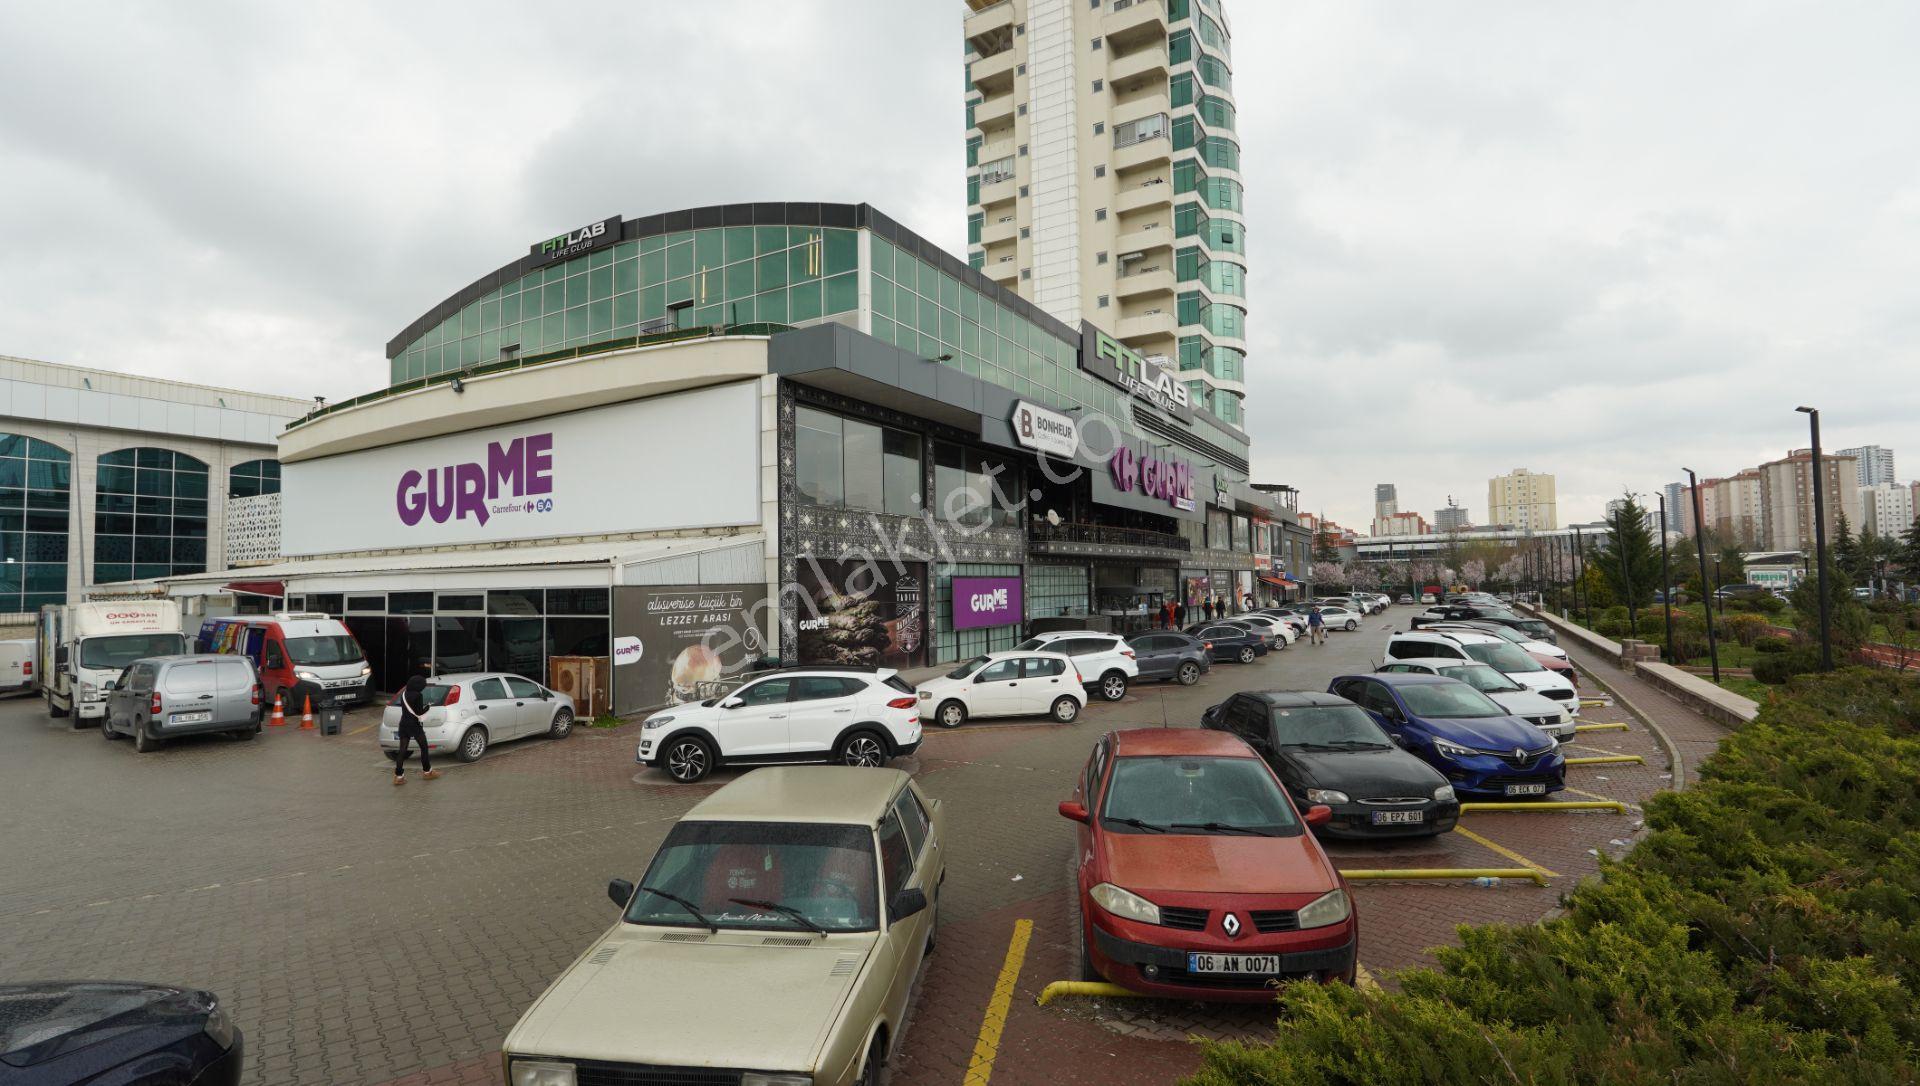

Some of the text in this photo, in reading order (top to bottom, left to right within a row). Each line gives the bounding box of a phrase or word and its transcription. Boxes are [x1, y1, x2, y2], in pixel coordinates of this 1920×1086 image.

[541, 221, 606, 255] FITLAB
[552, 240, 593, 259] LIFE CLUB
[1095, 330, 1188, 408] FITLAB
[1118, 371, 1176, 412] LIFE CLUB
[1037, 416, 1073, 439] BONHEUR
[396, 432, 553, 528] GURME
[1140, 456, 1195, 508] GURME
[492, 503, 521, 514] Carrefour
[698, 593, 727, 611] küçük
[970, 588, 1008, 613] GURME
[660, 612, 731, 626] LEZZET ARASI
[799, 616, 830, 631] GURME
[616, 644, 640, 655] GURME
[1377, 812, 1422, 822] 06 EPZ 601
[1197, 956, 1275, 972] 06 AN 0071
